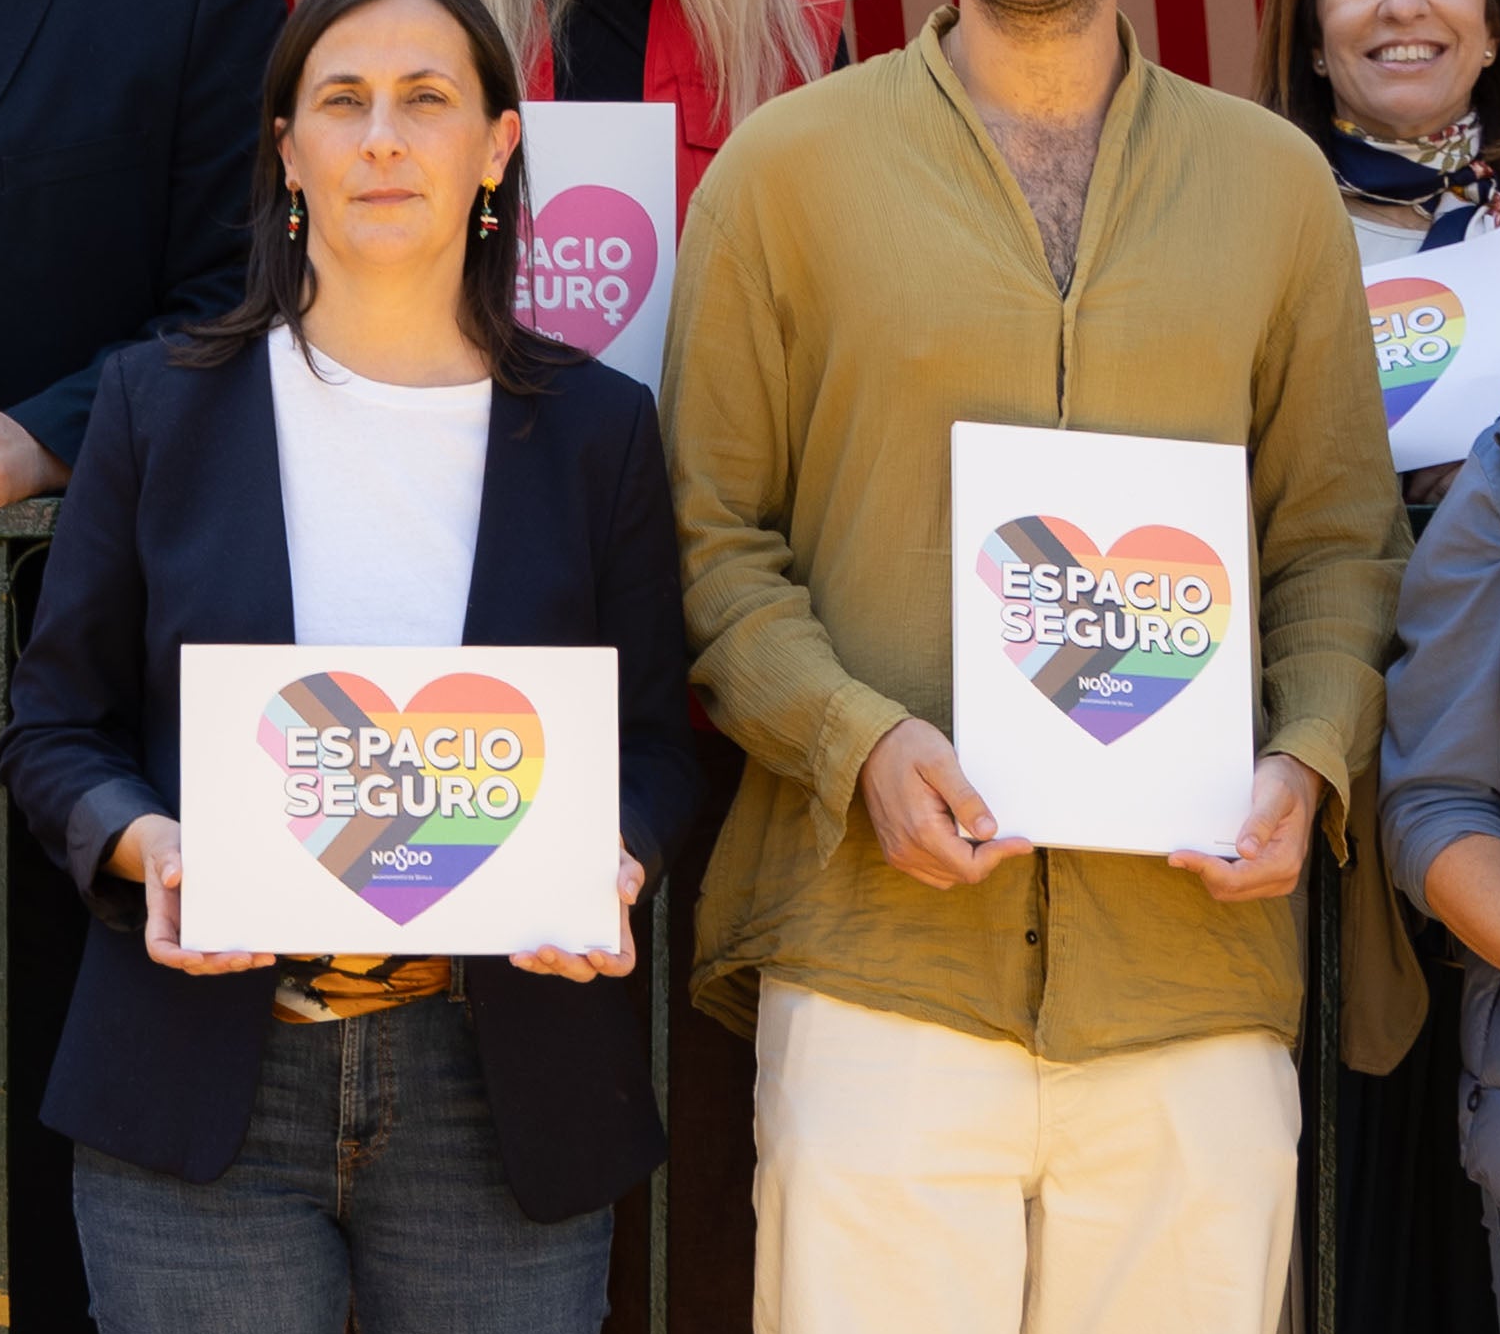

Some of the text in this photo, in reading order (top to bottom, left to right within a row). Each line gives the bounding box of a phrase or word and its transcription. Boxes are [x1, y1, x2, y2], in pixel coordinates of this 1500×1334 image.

[514, 275, 628, 326] GURO
[1002, 561, 1212, 614] ESPACIO
[1001, 604, 1210, 657] SEGURO
[285, 726, 523, 770] ESPACIO
[284, 773, 521, 819] SEGURO
